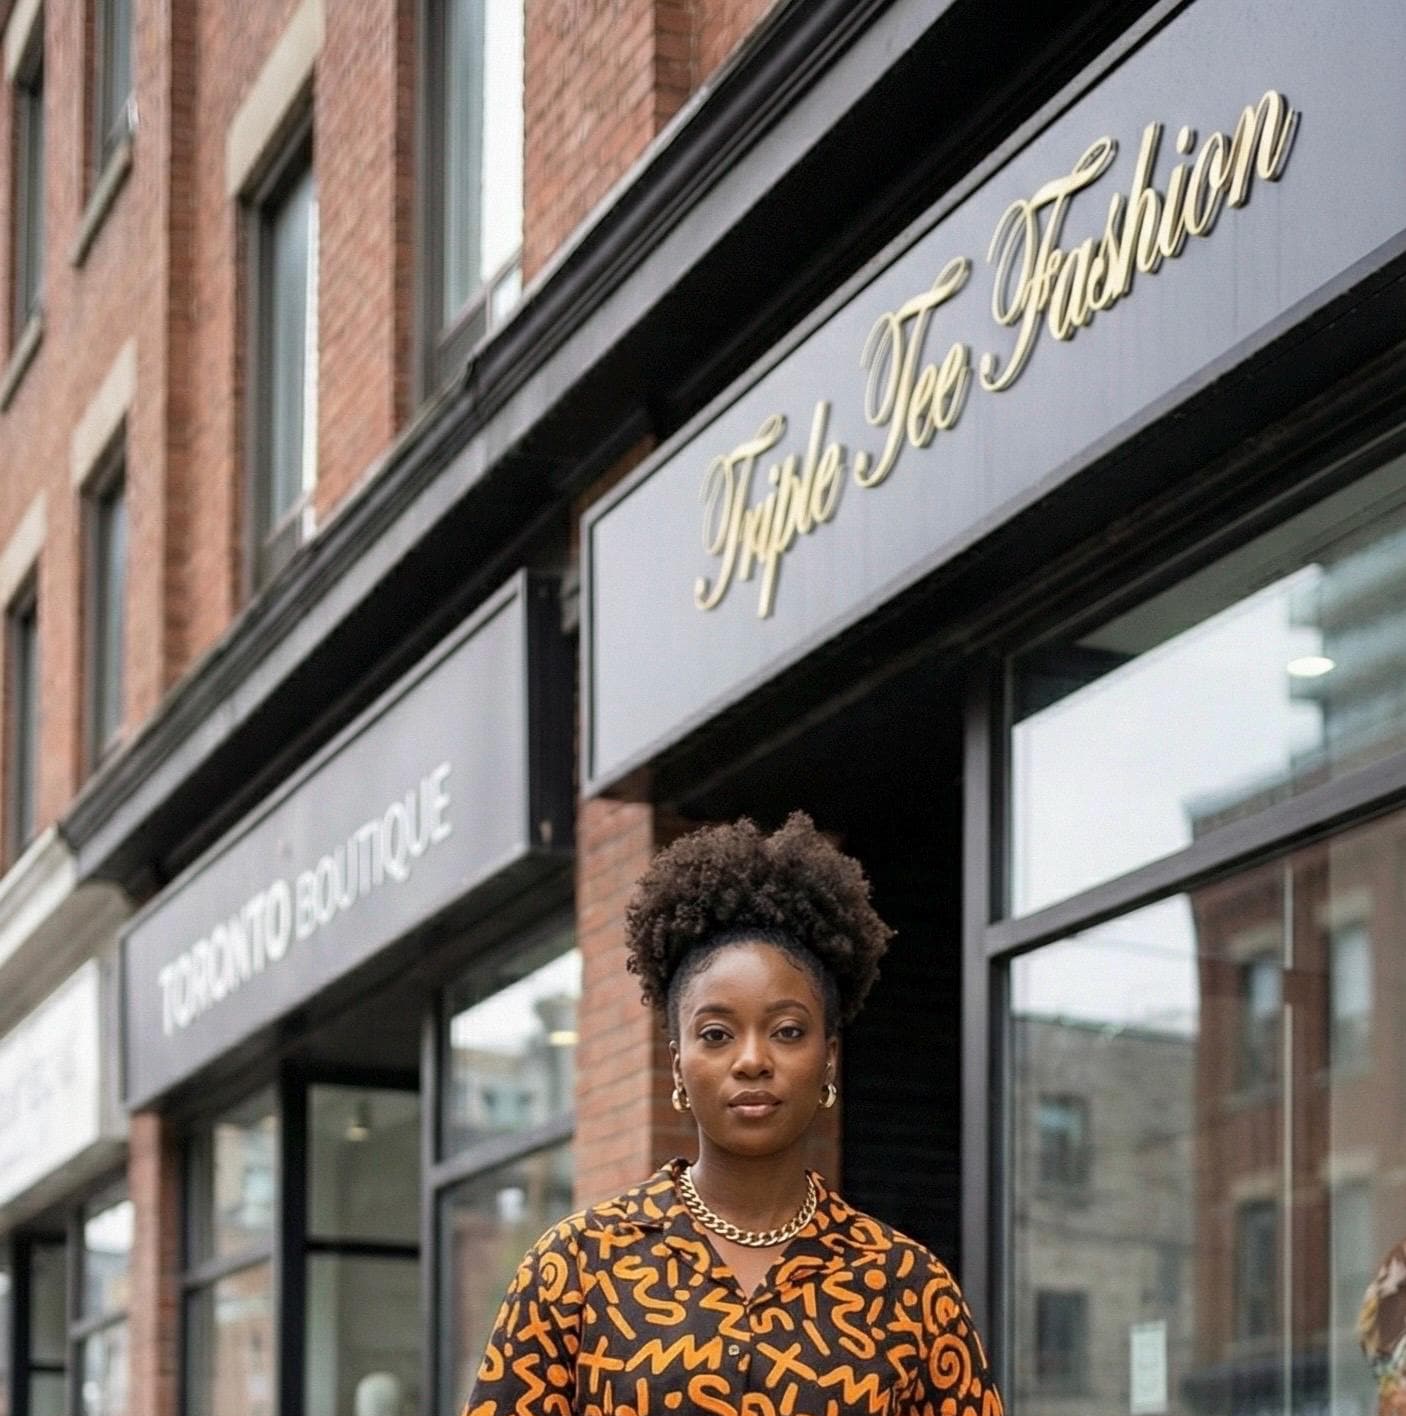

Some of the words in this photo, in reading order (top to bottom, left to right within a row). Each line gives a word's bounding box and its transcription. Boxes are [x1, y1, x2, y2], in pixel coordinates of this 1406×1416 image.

[694, 400, 844, 618] Triple
[855, 257, 972, 488] Tee
[979, 89, 1300, 391] Fashion
[158, 879, 292, 1036] TORONTO
[295, 761, 451, 940] BOUTIQUE
